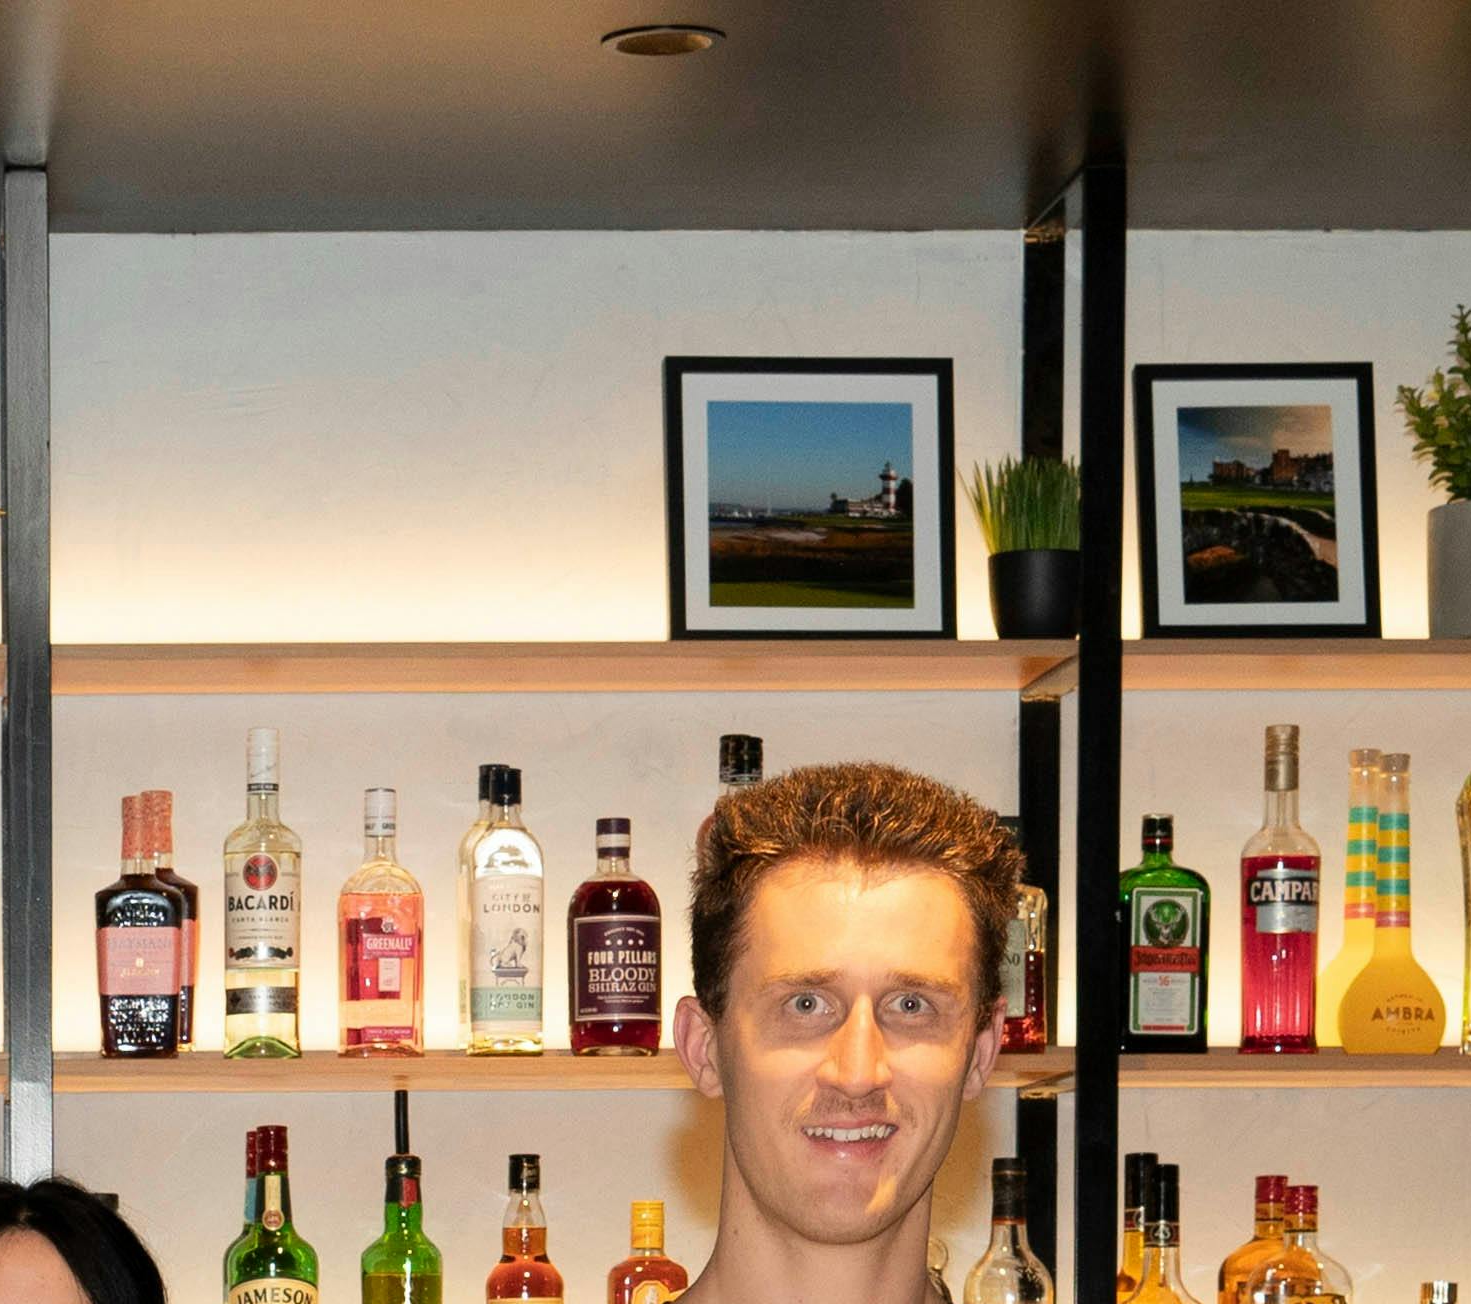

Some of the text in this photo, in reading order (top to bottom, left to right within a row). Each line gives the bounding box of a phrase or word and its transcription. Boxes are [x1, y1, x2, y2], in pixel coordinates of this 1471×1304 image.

[1250, 880, 1319, 903] CAMPAR
[483, 904, 541, 914] LONDON
[588, 950, 614, 966] FOUR
[588, 967, 657, 983] BLOODY
[588, 981, 637, 994] SHIRAZ
[1371, 1006, 1436, 1022] AMBRA
